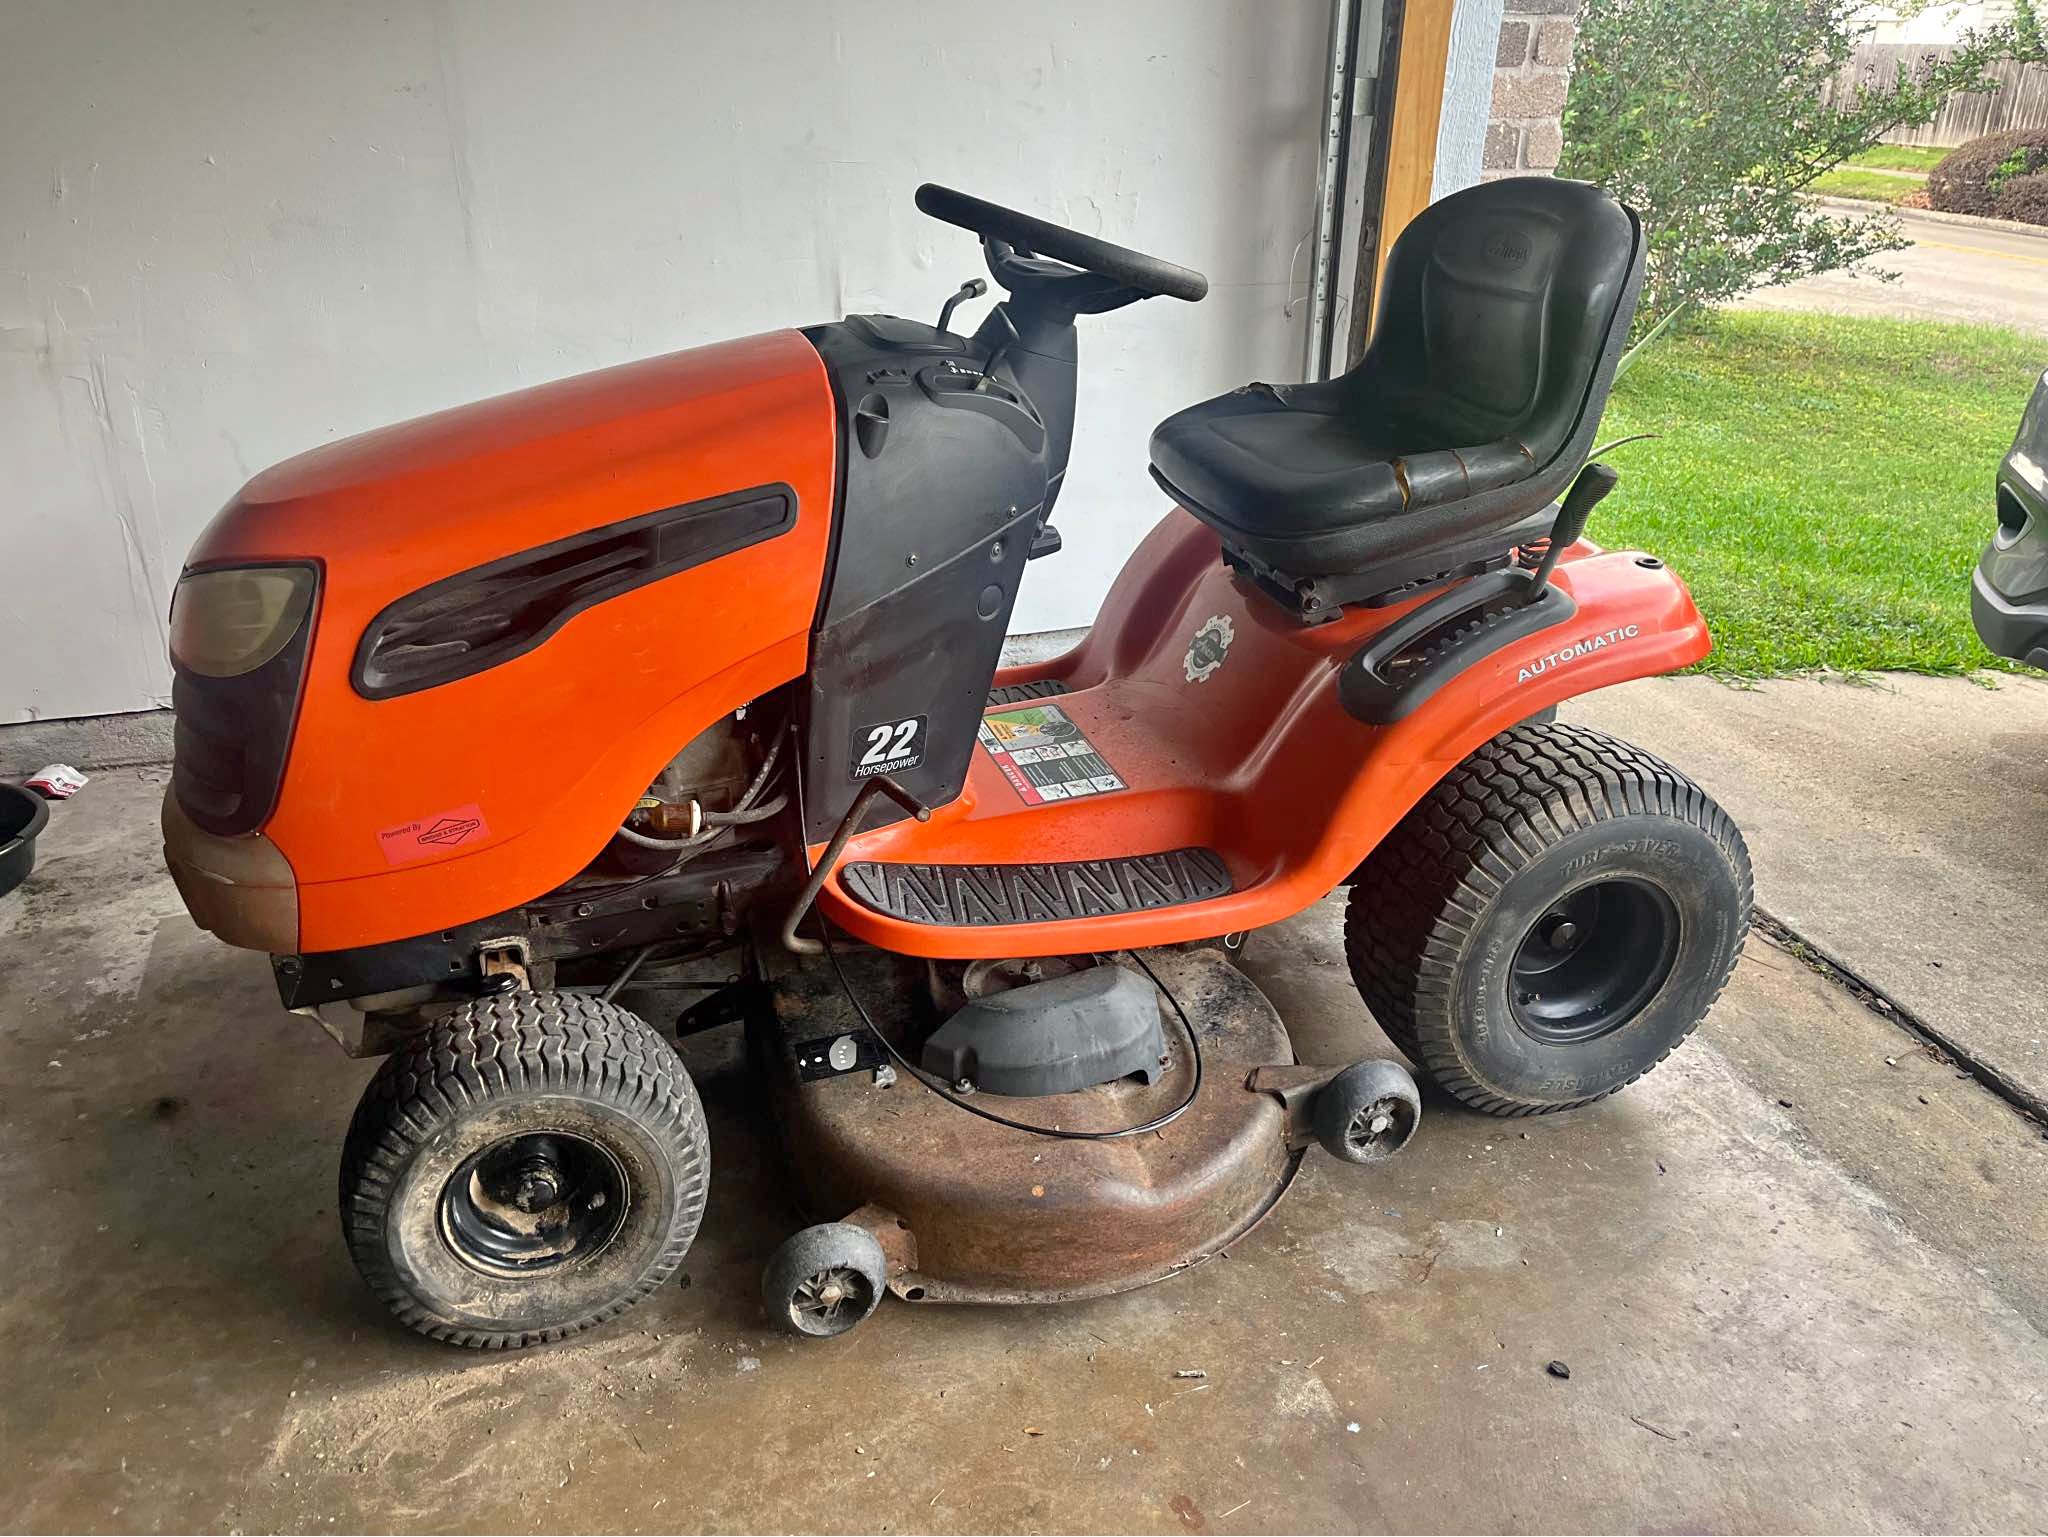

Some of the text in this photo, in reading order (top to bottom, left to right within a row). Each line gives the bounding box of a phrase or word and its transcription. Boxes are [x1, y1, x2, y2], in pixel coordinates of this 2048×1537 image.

[1518, 624, 1639, 683] AUTOMATIC
[860, 719, 918, 766] 22
[854, 755, 919, 777] Horsepower
[381, 823, 422, 841] Powered By
